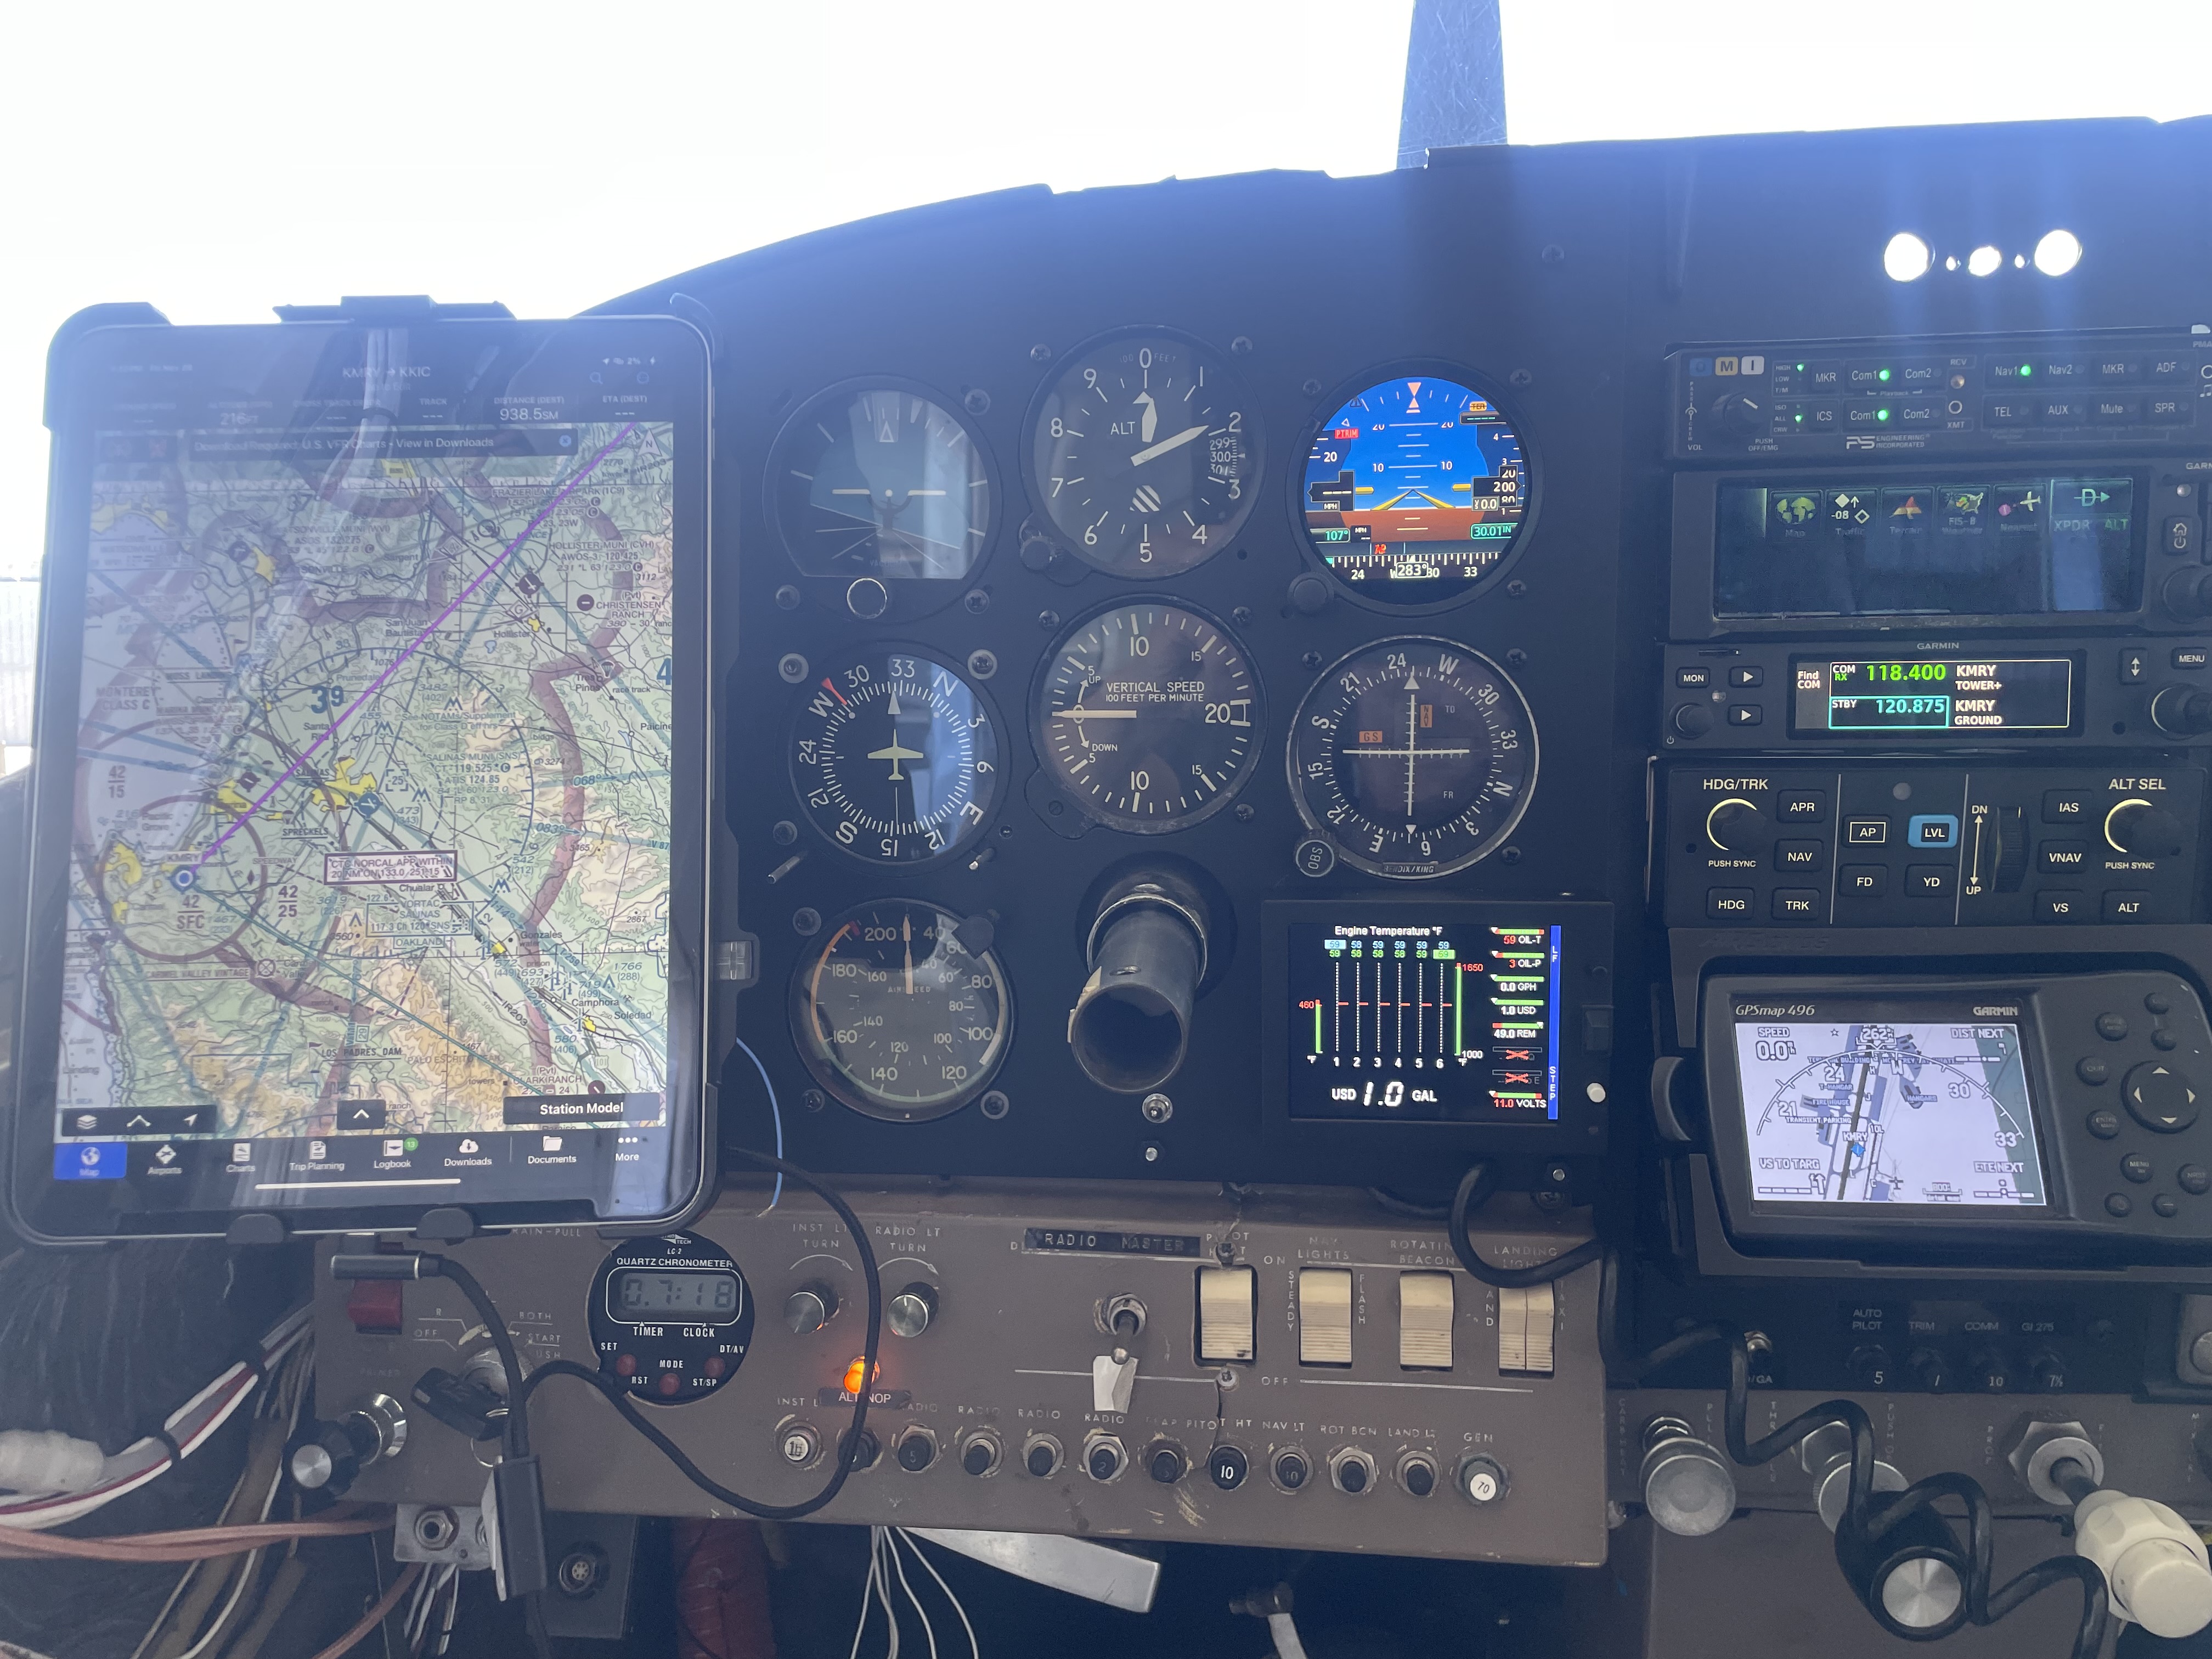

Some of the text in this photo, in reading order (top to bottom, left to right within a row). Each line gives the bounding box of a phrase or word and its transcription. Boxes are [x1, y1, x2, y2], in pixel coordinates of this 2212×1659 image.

[2049, 365, 2072, 374] Nav2
[2102, 364, 2124, 374] MKR
[2157, 363, 2176, 372] ADF
[1084, 369, 1097, 388] 9
[1816, 373, 1836, 382] MKR
[1905, 369, 1931, 379] Com2
[1995, 407, 2011, 416] TEL
[2048, 405, 2068, 415] AUX
[2101, 404, 2123, 414] Mute
[2155, 403, 2175, 413] SPR
[1816, 411, 1832, 421] ICS
[1904, 409, 1929, 419] Com2
[1051, 418, 1063, 437] 8
[1110, 422, 1135, 435] ALT
[1324, 452, 1337, 462] 20
[1373, 461, 1452, 472] 10 10
[1085, 525, 1097, 544] 6
[1192, 525, 1207, 544] 4
[1140, 543, 1152, 562] 5
[1351, 569, 1364, 579] 24
[1464, 567, 1477, 577] 33
[1387, 653, 1406, 669] 24
[891, 659, 915, 678] 33
[1867, 664, 1946, 681] 118.400
[1956, 665, 1996, 676] KMRY
[844, 665, 869, 687] 30
[1684, 674, 1704, 682] MON
[1798, 671, 1819, 680] Find
[933, 671, 959, 697] N
[1107, 682, 1204, 692] VERTICAL SPEED
[1798, 680, 1820, 689] COM
[1955, 681, 2002, 690] TOWER+
[1105, 694, 1204, 702] 100 FEET PER MINUTE
[1832, 700, 1857, 708] STBY
[1876, 699, 1945, 713] 120.875
[1955, 700, 1995, 712] KMRY
[1205, 703, 1230, 723] 20
[1954, 716, 2002, 725] GROUND
[1703, 779, 1768, 791] HDG/TRK
[2109, 779, 2166, 790] ALT SEL
[1790, 803, 1815, 812] APR
[1972, 805, 1988, 814] DN
[2059, 803, 2079, 812] IAS
[1860, 828, 1876, 837] AP
[1925, 828, 1945, 837] LVL
[1308, 847, 1323, 870] OBS
[1788, 853, 1812, 861] NAV
[2049, 853, 2081, 862] VNAV
[1857, 878, 1872, 887] FD
[1923, 878, 1939, 887] YD
[279, 885, 297, 898] 42
[1718, 900, 1745, 910] HDG
[1786, 901, 1809, 910] TRK
[2053, 904, 2068, 912] VS
[2118, 904, 2139, 912] ALT
[279, 905, 297, 917] 25
[865, 927, 896, 941] 200
[1335, 926, 1430, 936] Engine Temperature
[832, 964, 856, 977] 180
[971, 975, 992, 988] 80
[1500, 983, 1515, 991] 0.0
[1501, 1006, 1515, 1015] 1.0
[1736, 1005, 1815, 1017] GPSmap 496
[1973, 1007, 2018, 1015] GARMIN
[864, 1016, 883, 1026] 140
[833, 1030, 857, 1043] 160
[1494, 1030, 1515, 1039] 49.0
[1758, 1028, 1790, 1037] SPEED
[1951, 1028, 2004, 1038] DIST NEXT
[321, 1049, 336, 1057] LOS
[343, 1048, 376, 1056] PADRES
[871, 1068, 898, 1081] 140
[942, 1066, 967, 1079] 120
[1331, 1081, 1437, 1107] USD 1.0 GAL
[540, 1102, 624, 1115] Station Model
[1494, 1099, 1546, 1108] 11.0 VOLTS
[444, 1157, 492, 1166] Downloads
[528, 1155, 577, 1164] Documents
[615, 1153, 639, 1161] More
[290, 1161, 345, 1171] Trip Planning
[374, 1160, 411, 1169] Logbook
[1759, 1159, 1820, 1169] VS TO TARG
[1974, 1161, 2024, 1172] ETE NEXT
[876, 1227, 940, 1237] RADIO LT
[1045, 1233, 1184, 1251] RADIO MASTER
[890, 1243, 926, 1252] TURN
[1298, 1250, 1348, 1260] LIGHTS
[1400, 1255, 1454, 1265] BEACON
[658, 1259, 732, 1267] CHRONOMETER
[1264, 1256, 1285, 1265] ON
[633, 1327, 663, 1336] TIMER
[684, 1328, 714, 1337] CLOCK
[1262, 1376, 1288, 1386] OFF
[839, 1392, 858, 1402] ALT
[1085, 1414, 1124, 1424] RADIO
[1187, 1418, 1251, 1430] PITOT HT
[1262, 1421, 1305, 1431] NAV LT
[1464, 1433, 1493, 1442] GEN
